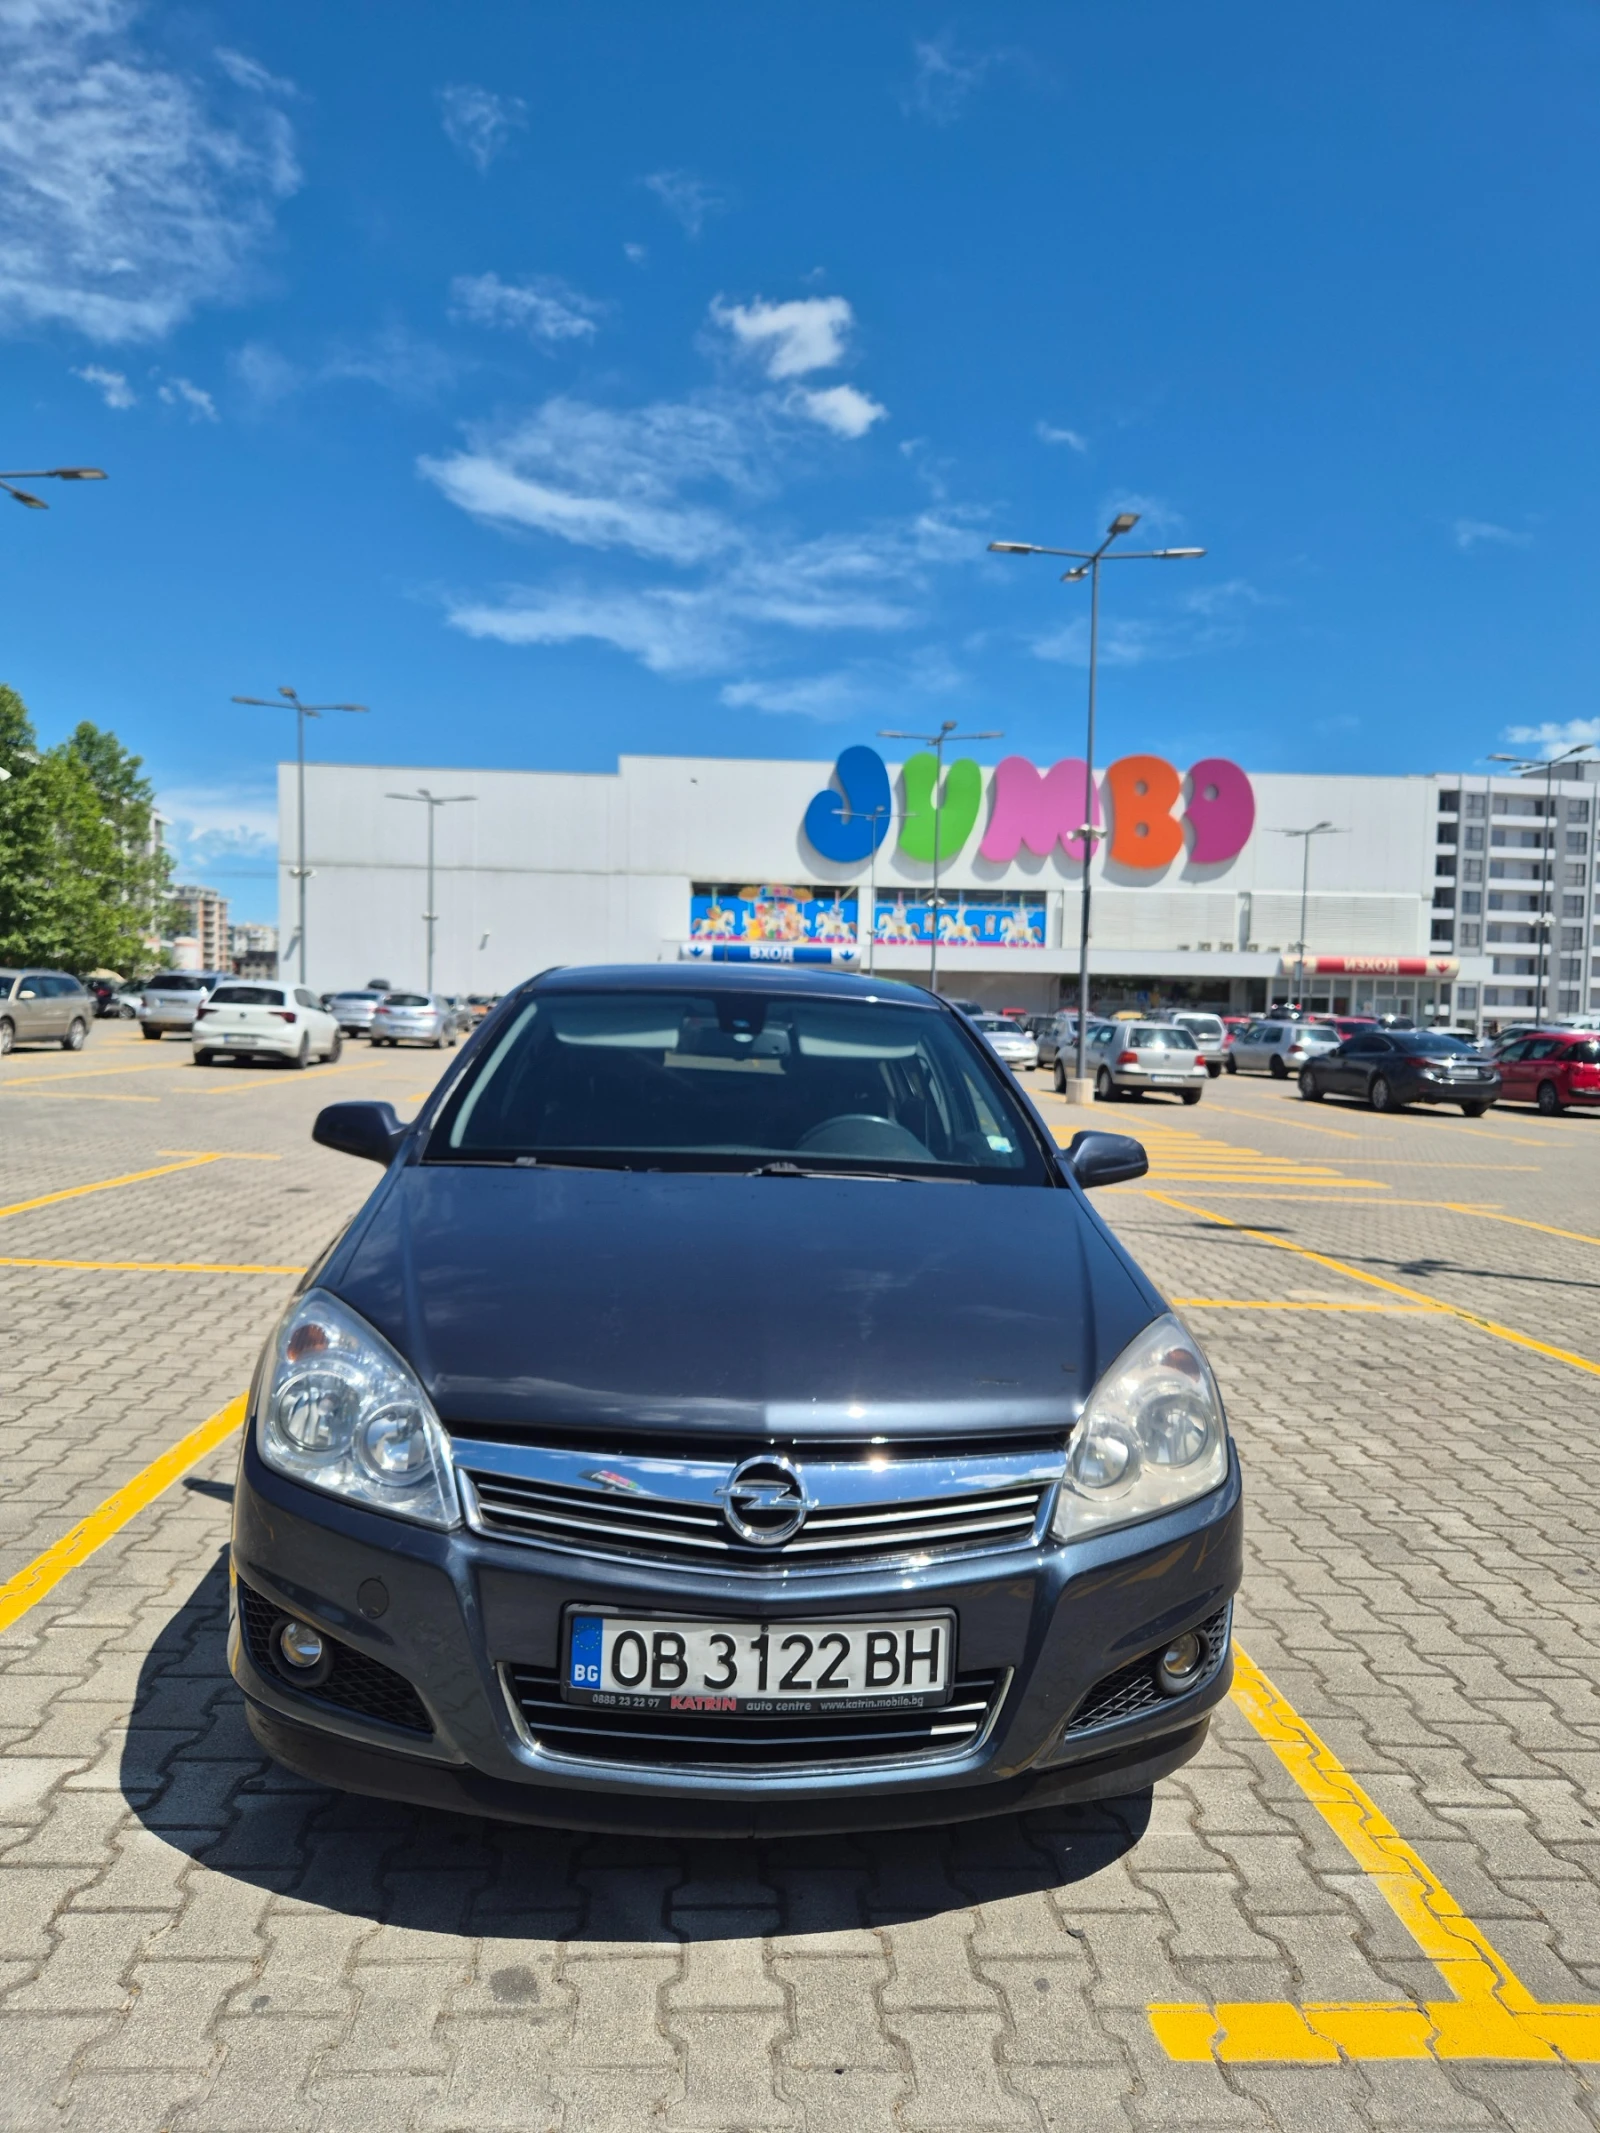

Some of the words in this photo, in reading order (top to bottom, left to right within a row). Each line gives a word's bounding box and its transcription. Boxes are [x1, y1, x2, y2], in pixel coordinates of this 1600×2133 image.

[804, 745, 1255, 869] JUMBO
[749, 945, 794, 963] ВХОД
[1343, 957, 1399, 974] ИЗХОД
[703, 1633, 850, 1691] 3122
[865, 1628, 940, 1688] BH
[574, 1664, 598, 1682] BG
[618, 1696, 631, 1706] 23
[633, 1697, 645, 1708] 22
[647, 1699, 660, 1708] 97
[670, 1696, 737, 1711] KATRIN
[746, 1701, 773, 1711] auto
[776, 1701, 812, 1711] centre
[820, 1695, 924, 1710] www.katrin.mobile.bg
